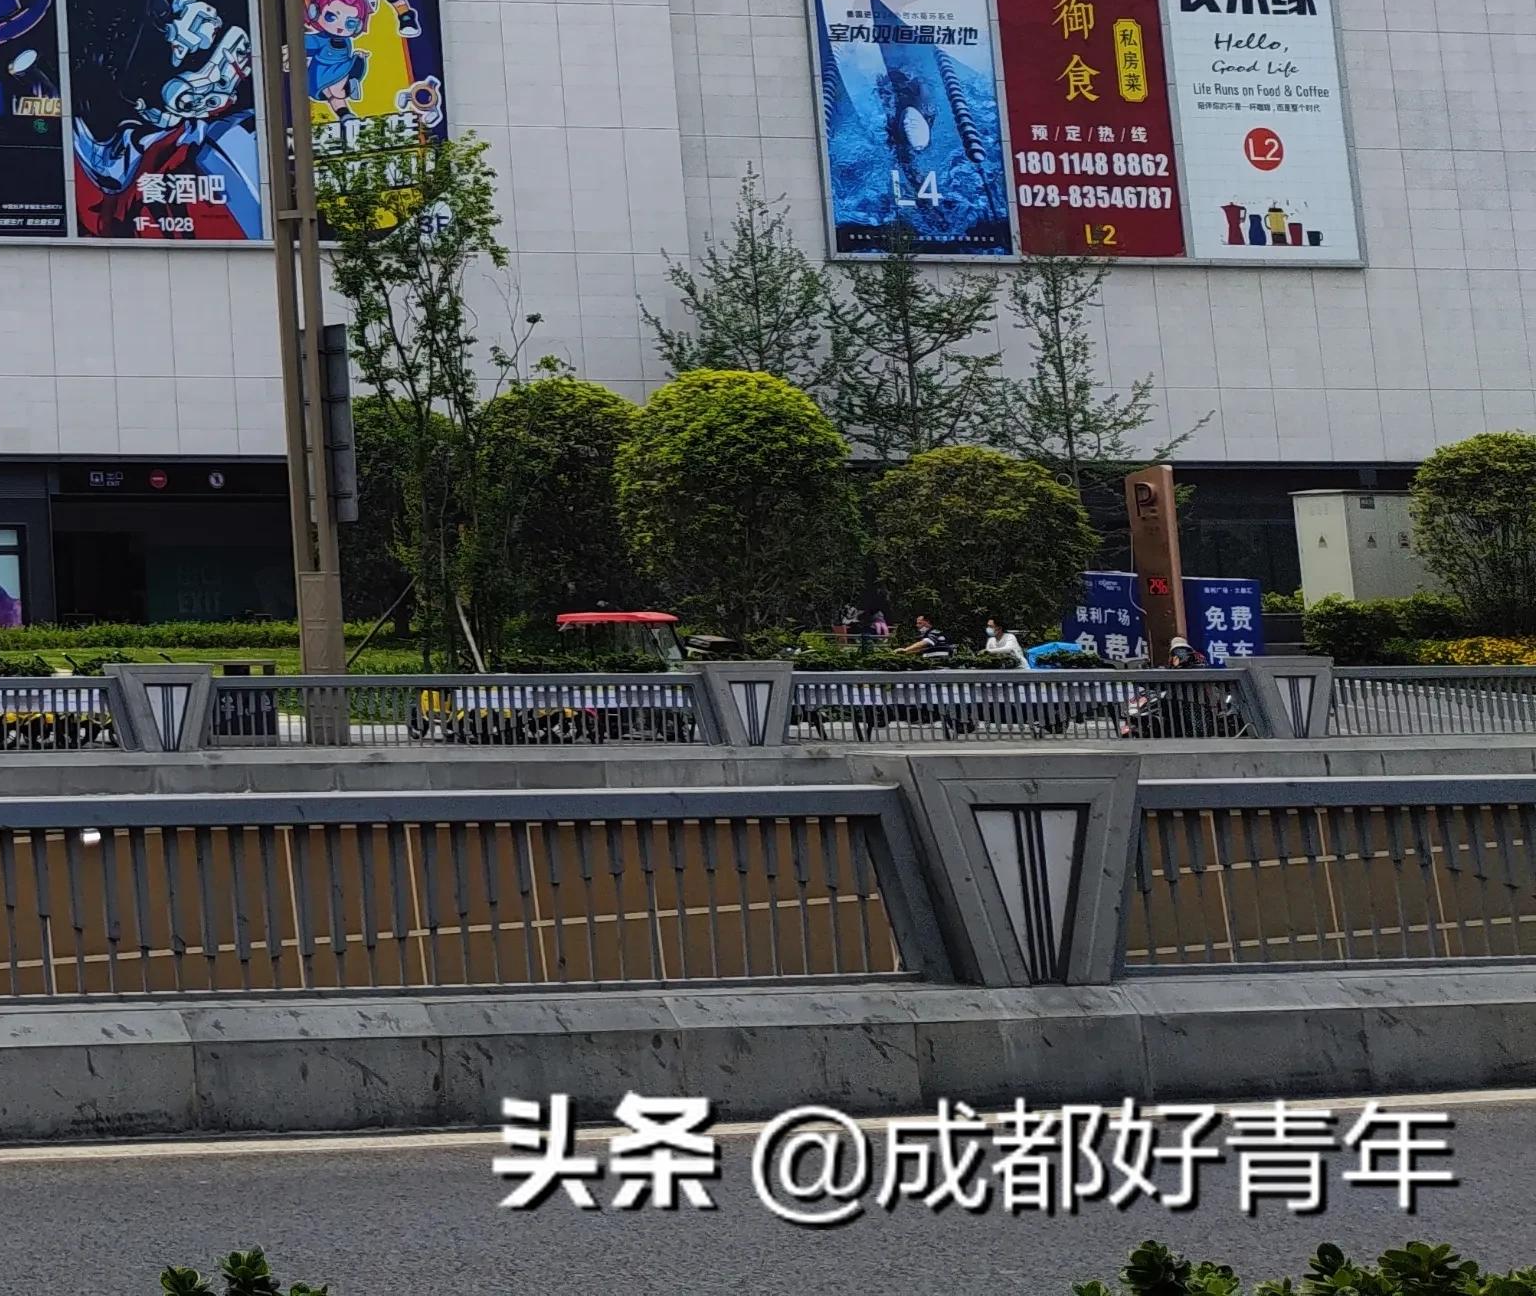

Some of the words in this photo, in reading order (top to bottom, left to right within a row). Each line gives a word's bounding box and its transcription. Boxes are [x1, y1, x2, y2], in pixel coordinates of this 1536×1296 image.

[828, 23, 978, 46] 室内双恒温泳池
[1214, 32, 1289, 53] Hello,
[1119, 28, 1142, 93] 私房菜
[1211, 60, 1261, 75] Good
[1267, 61, 1300, 78] Life
[1193, 83, 1211, 95] Life
[1214, 83, 1239, 96] Runs
[1242, 87, 1254, 96] on
[1257, 85, 1281, 97] Food
[1284, 86, 1292, 97] &
[1295, 85, 1330, 98] Coffee
[1248, 138, 1281, 161] L2
[1015, 151, 1056, 175] 180
[1059, 152, 1109, 175] 1148
[1112, 153, 1170, 177] 8862
[136, 171, 227, 204] 餐酒吧
[891, 170, 943, 206] L4
[1018, 184, 1172, 209] 028-83546787
[1085, 224, 1117, 244] L2
[1205, 605, 1253, 631] 免费
